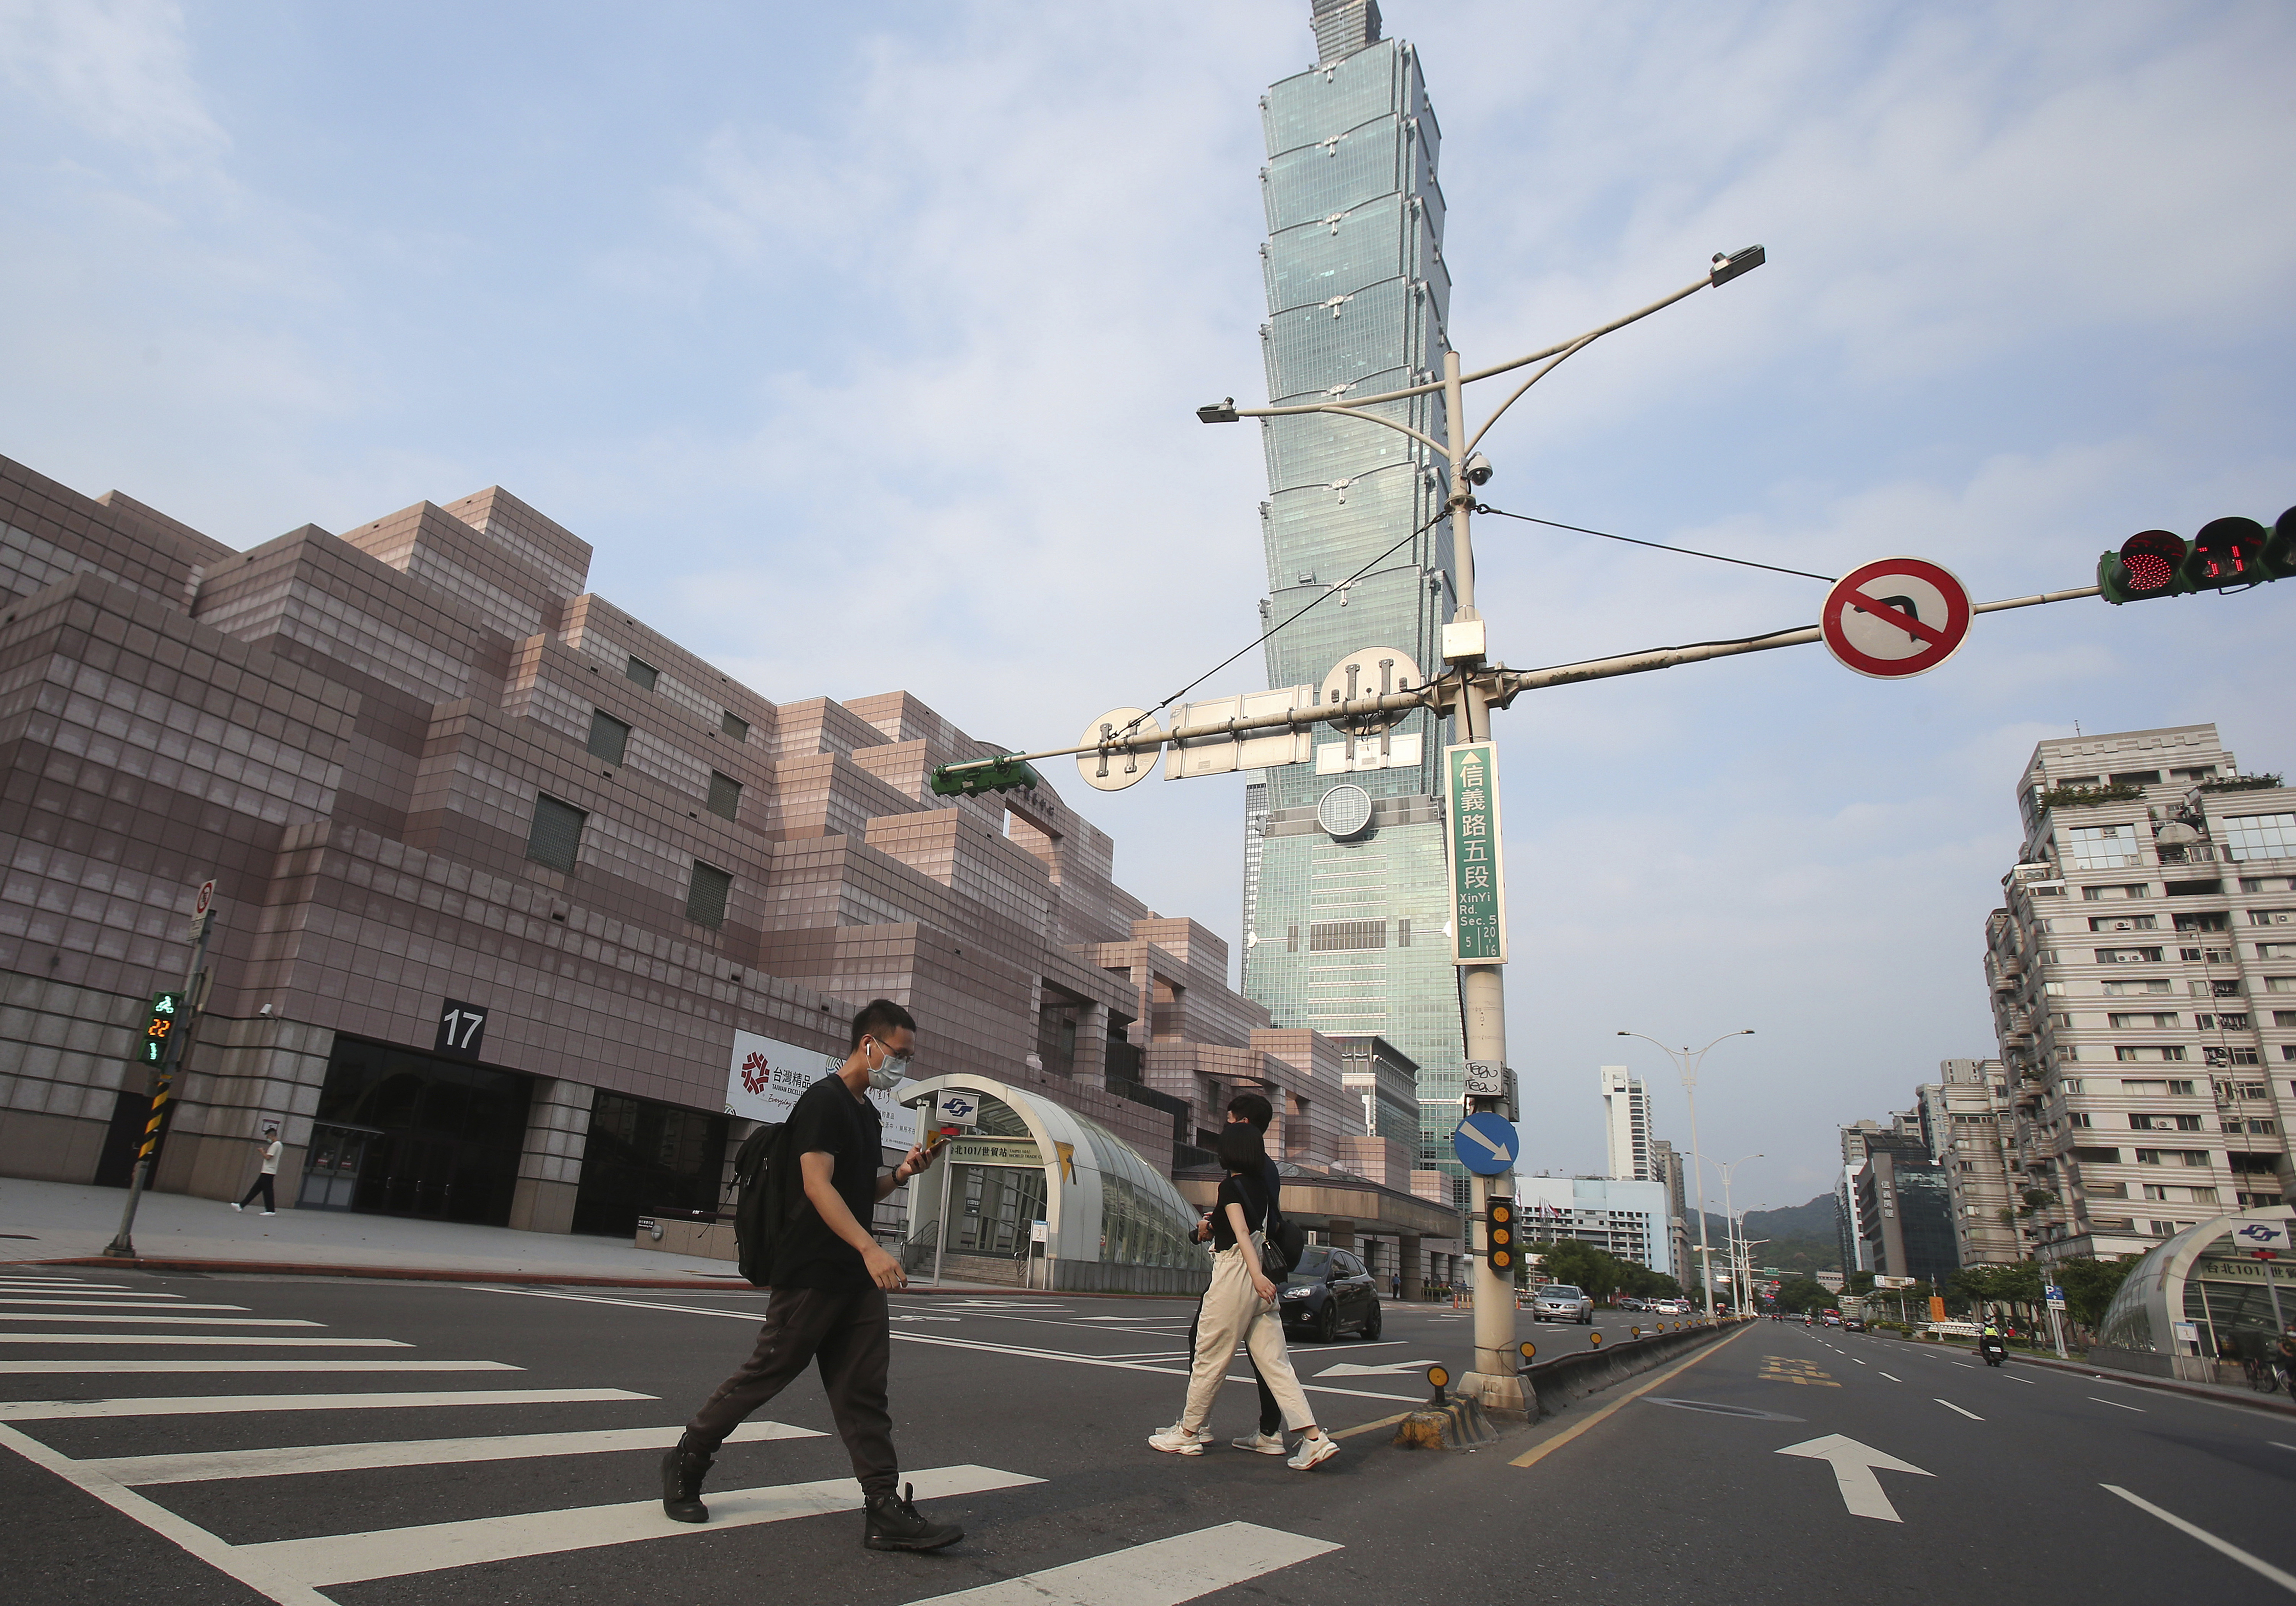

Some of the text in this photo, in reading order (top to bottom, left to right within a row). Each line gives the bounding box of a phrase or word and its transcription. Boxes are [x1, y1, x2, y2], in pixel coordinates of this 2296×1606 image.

[1460, 765, 1490, 889] 信義路五段
[1459, 892, 1491, 904] XinYi
[1459, 905, 1478, 915] Rd.
[1460, 915, 1497, 927] Sec. 5
[1484, 927, 1496, 938] 20
[1466, 937, 1471, 948] 5
[1486, 945, 1497, 956] 16
[148, 1019, 170, 1037] 22
[444, 1009, 483, 1049] 17
[773, 1066, 811, 1089] 台灣精品
[772, 1084, 805, 1096] TAIWAN EXCELLE
[768, 1094, 792, 1110] Everyday
[2045, 1285, 2054, 1295] P
